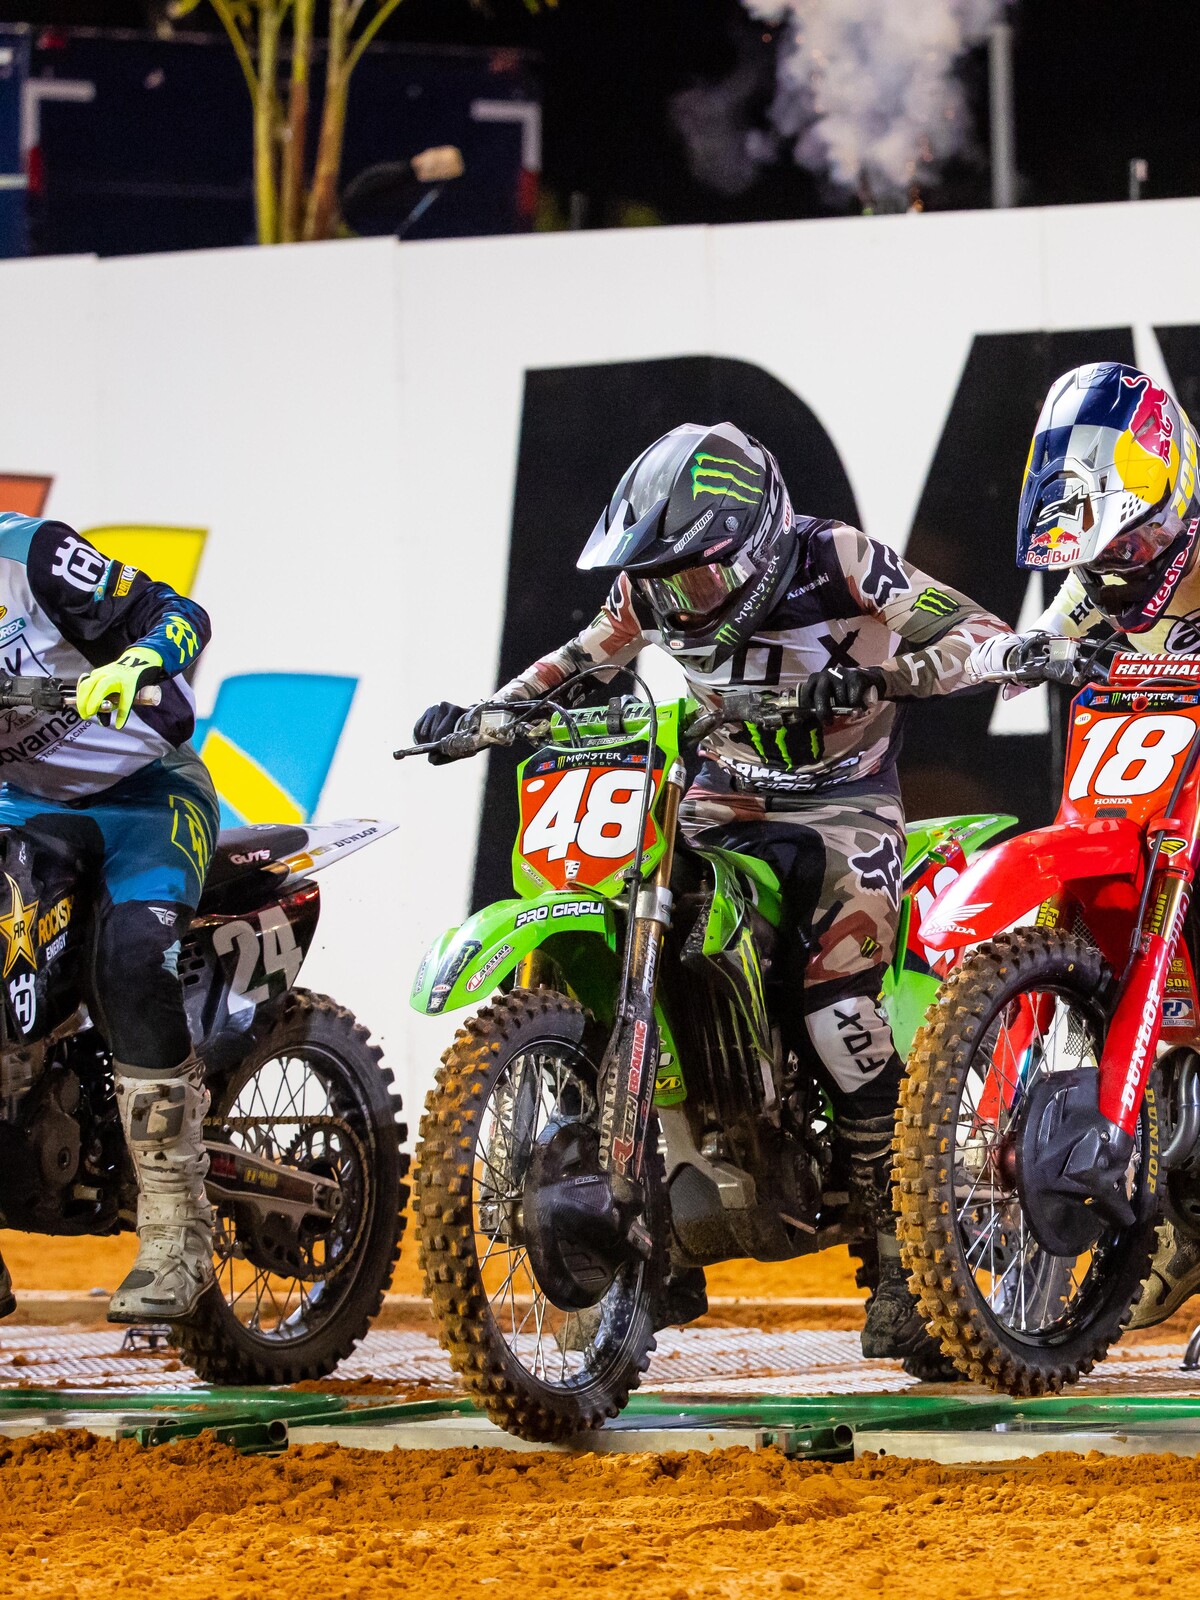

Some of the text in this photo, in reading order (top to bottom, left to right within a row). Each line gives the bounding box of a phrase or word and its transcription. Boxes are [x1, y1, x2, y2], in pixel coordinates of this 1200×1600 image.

[1026, 547, 1081, 565] Red Bull
[1142, 566, 1179, 618] Red
[1114, 663, 1200, 676] RENTHAL
[1121, 692, 1175, 702] MONSTER
[566, 752, 622, 763] MONSTER
[1068, 714, 1197, 802] 18
[522, 768, 656, 863] 48
[1093, 797, 1133, 805] HONDA
[334, 827, 379, 848] DUNLOP
[516, 902, 604, 928] PRO CIRCUI
[213, 905, 304, 1006] 24
[628, 1019, 648, 1095] BRAKING
[832, 1008, 886, 1075] FOX
[1121, 978, 1161, 1112] DUNLOP
[598, 1058, 620, 1171] DUNLO
[1144, 1087, 1160, 1195] DUNLOP
